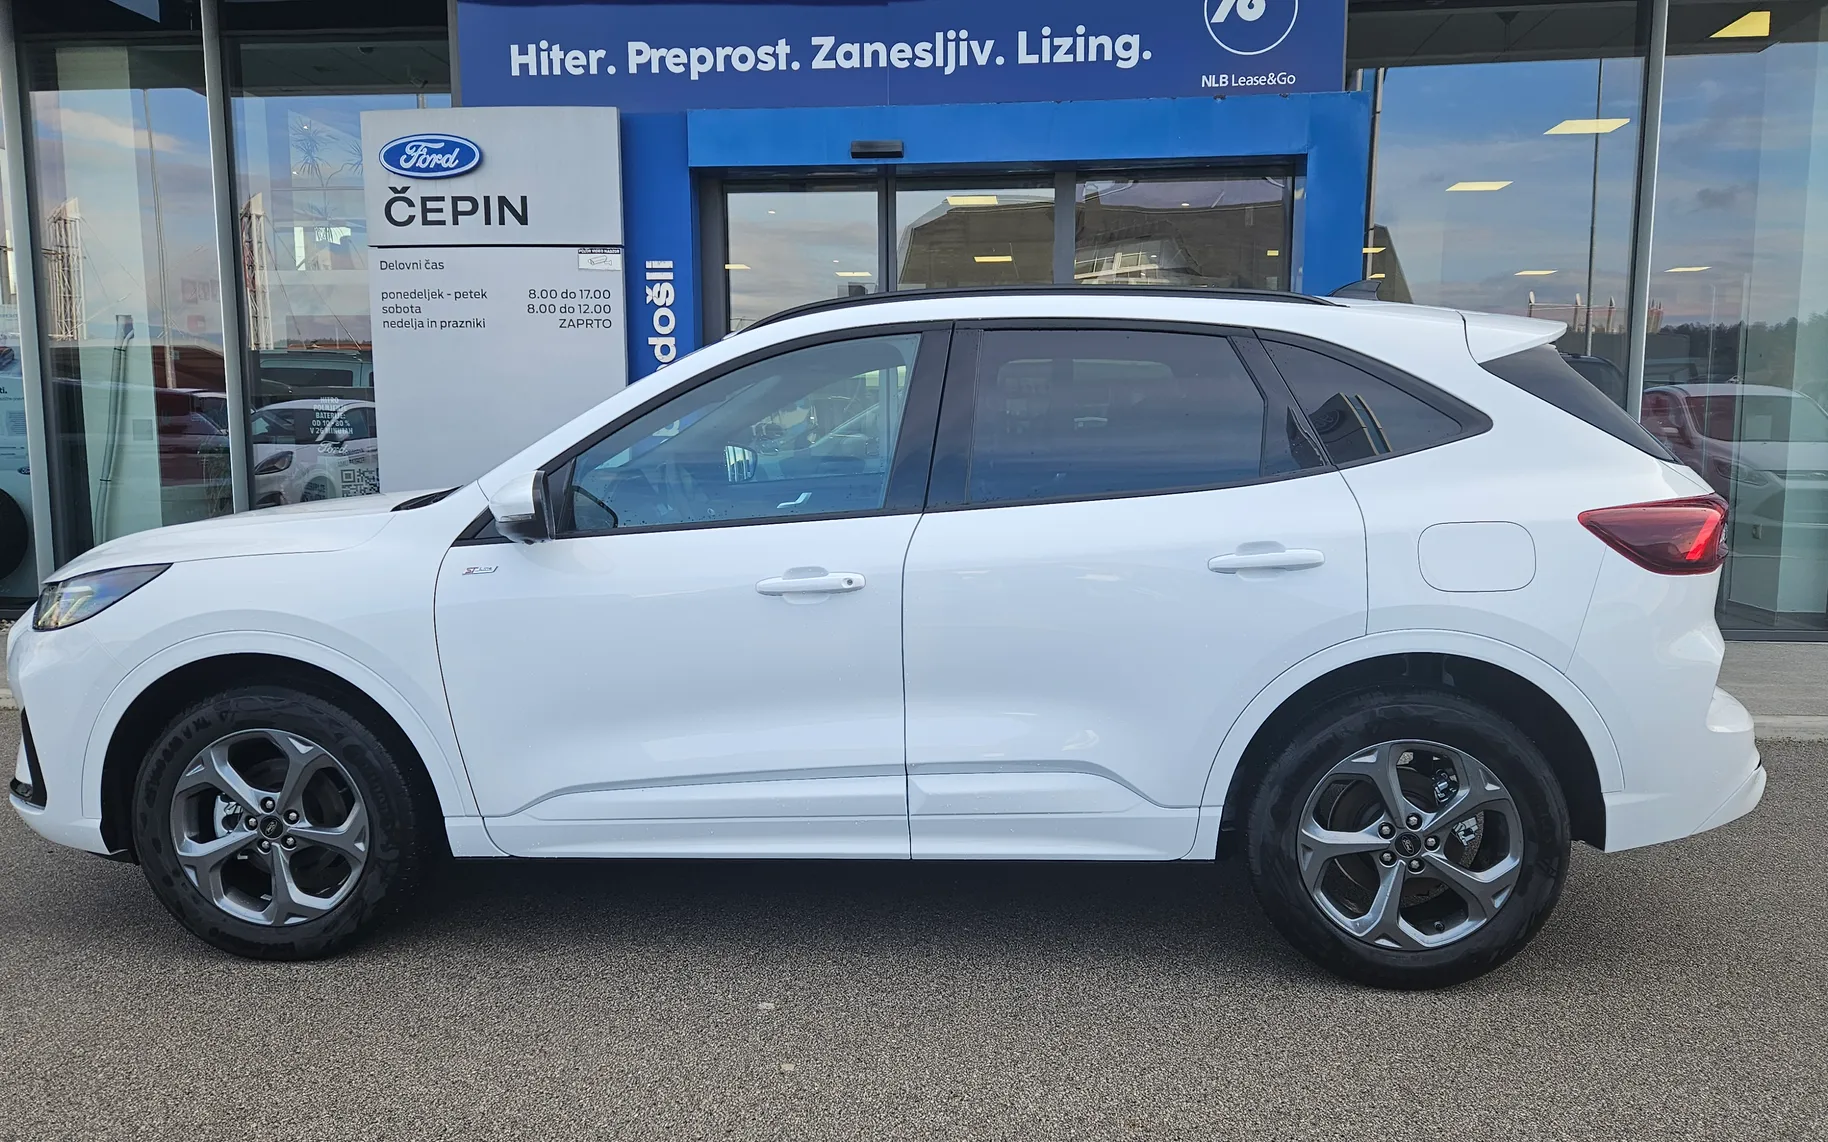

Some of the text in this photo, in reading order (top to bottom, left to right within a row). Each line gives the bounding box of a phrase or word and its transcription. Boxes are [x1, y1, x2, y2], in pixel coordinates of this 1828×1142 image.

[509, 25, 1152, 81] Hiter. Preprost. Zanesljiv. Lizing.
[1201, 72, 1296, 88] NLB Lease&Go
[399, 141, 460, 169] Ford
[384, 186, 529, 227] ČEPIN
[379, 258, 445, 271] Delovni čas
[381, 288, 445, 302] ponedeljek
[454, 288, 488, 302] petek
[528, 288, 611, 300] 8.00 do 17.00
[381, 303, 422, 315] sobota
[527, 303, 612, 315] 8.00 do 12.00
[382, 317, 486, 331] nedelja in prazniki
[558, 318, 613, 329] ZAPRTO
